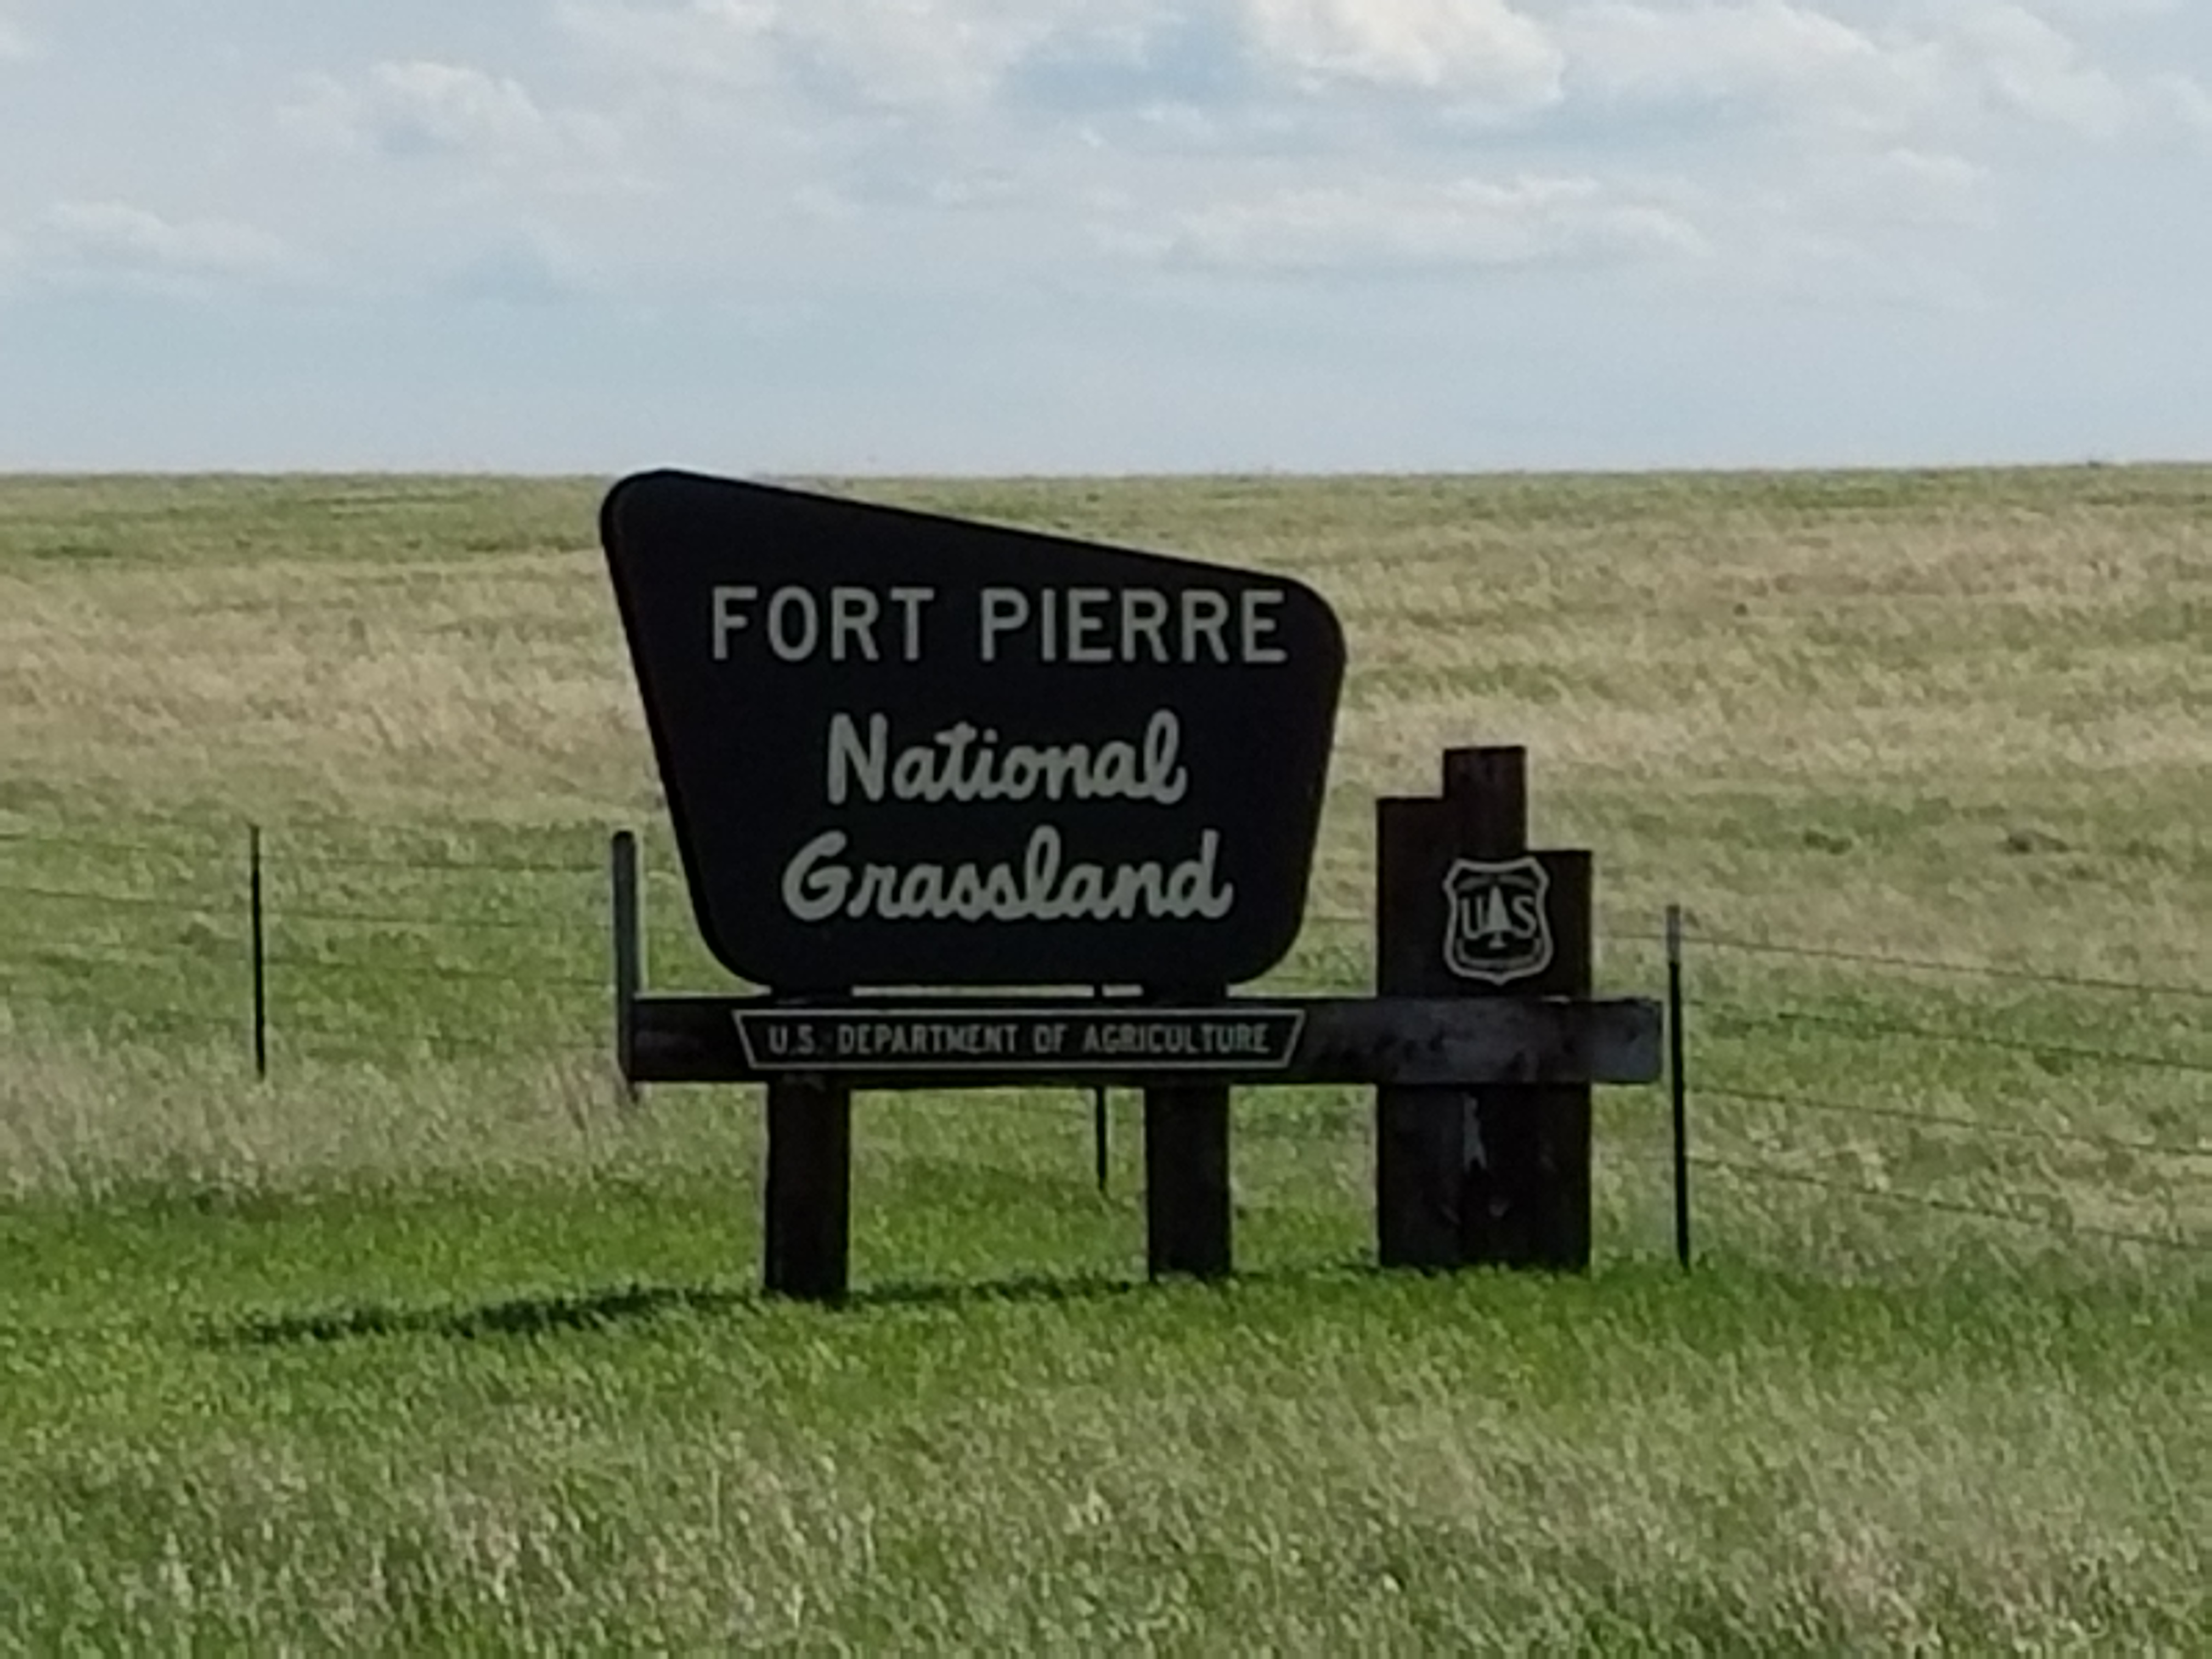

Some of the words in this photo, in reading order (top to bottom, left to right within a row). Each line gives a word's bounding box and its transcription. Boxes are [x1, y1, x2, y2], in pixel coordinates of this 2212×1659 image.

[714, 587, 934, 659] FORT
[981, 589, 1286, 661] PIERRE
[828, 710, 1187, 803] National
[782, 825, 1233, 920] Grassland
[769, 1025, 821, 1054] U.S.
[838, 1025, 1018, 1053] DEPARTMENT
[1034, 1025, 1068, 1052] OF
[1084, 1024, 1270, 1053] AGRICULTURE
